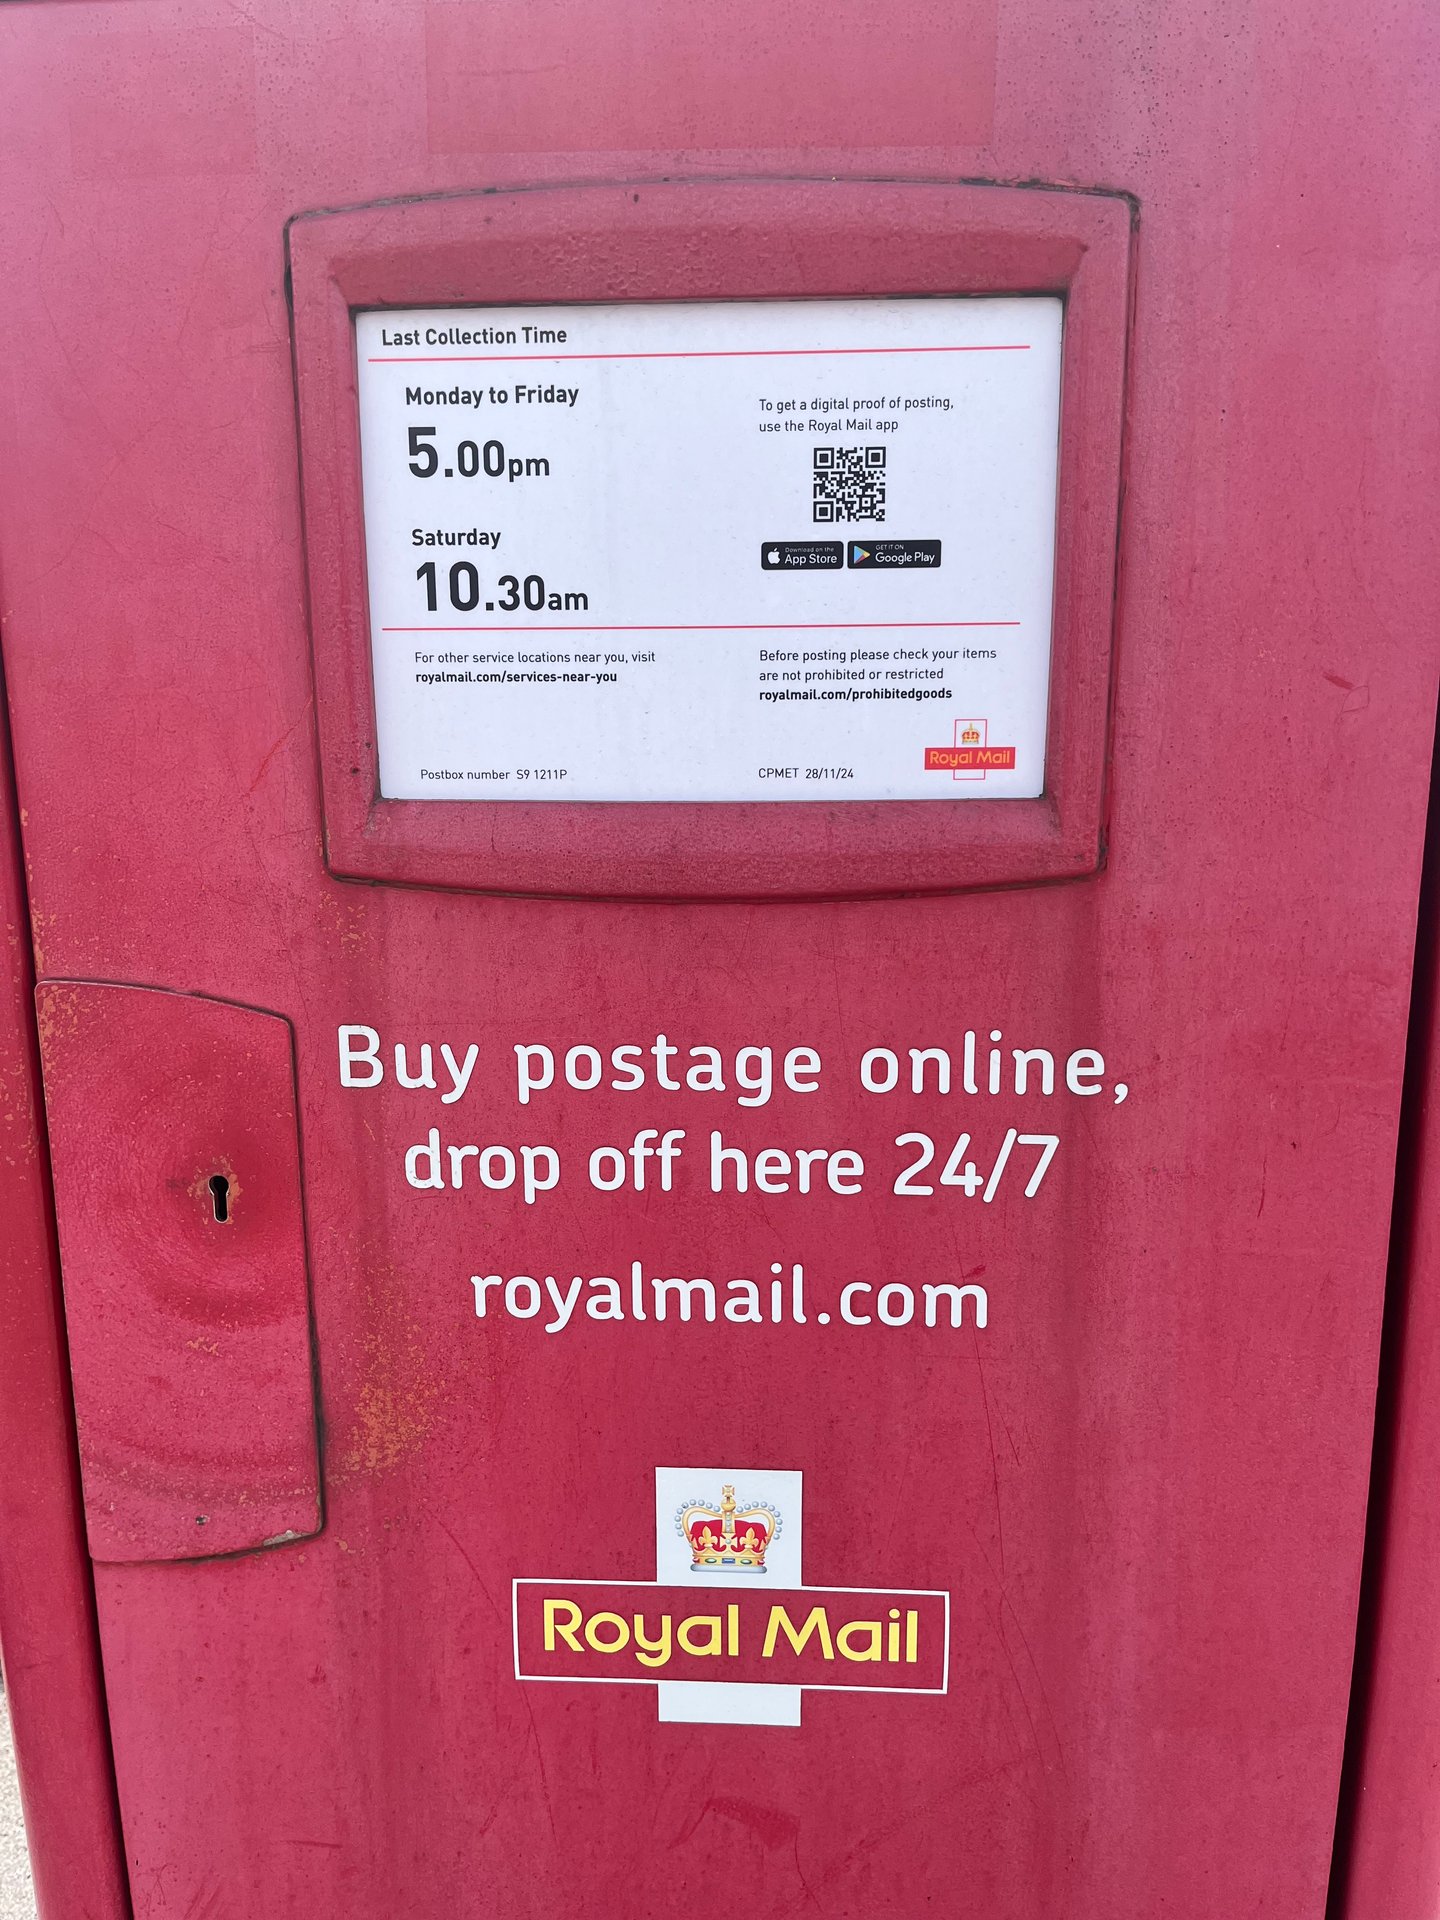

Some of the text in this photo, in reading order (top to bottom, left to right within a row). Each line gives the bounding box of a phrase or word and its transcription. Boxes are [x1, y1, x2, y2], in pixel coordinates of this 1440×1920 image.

[382, 326, 568, 346] Last Collection Time
[405, 384, 580, 409] Monday to Friday
[759, 396, 954, 414] To get a digital proof of posting,
[759, 418, 899, 434] use the Royal Mail app
[407, 426, 550, 483] 5.00pm
[411, 528, 501, 550] Saturday
[784, 553, 838, 566] App Store
[875, 551, 936, 565] Google Play
[416, 561, 589, 612] 10.30am
[414, 651, 656, 665] For other service locations near you, visit
[759, 648, 997, 663] Before posting please check your items
[415, 670, 617, 685] royalmail.com/services-near-you
[759, 668, 944, 683] are not prohibited or restricted
[759, 687, 953, 703] royalmail.com/prohibitedgoods
[929, 750, 1010, 767] Royal Mail
[420, 769, 567, 780] Postbox number S9 1211P
[758, 767, 854, 780] CPMET 28/11/24
[338, 1025, 1129, 1107] Buy postage online,
[404, 1128, 1061, 1204] drop off here 24/7
[470, 1261, 988, 1333] royalmail.com
[543, 1598, 918, 1667] Royal Mail
